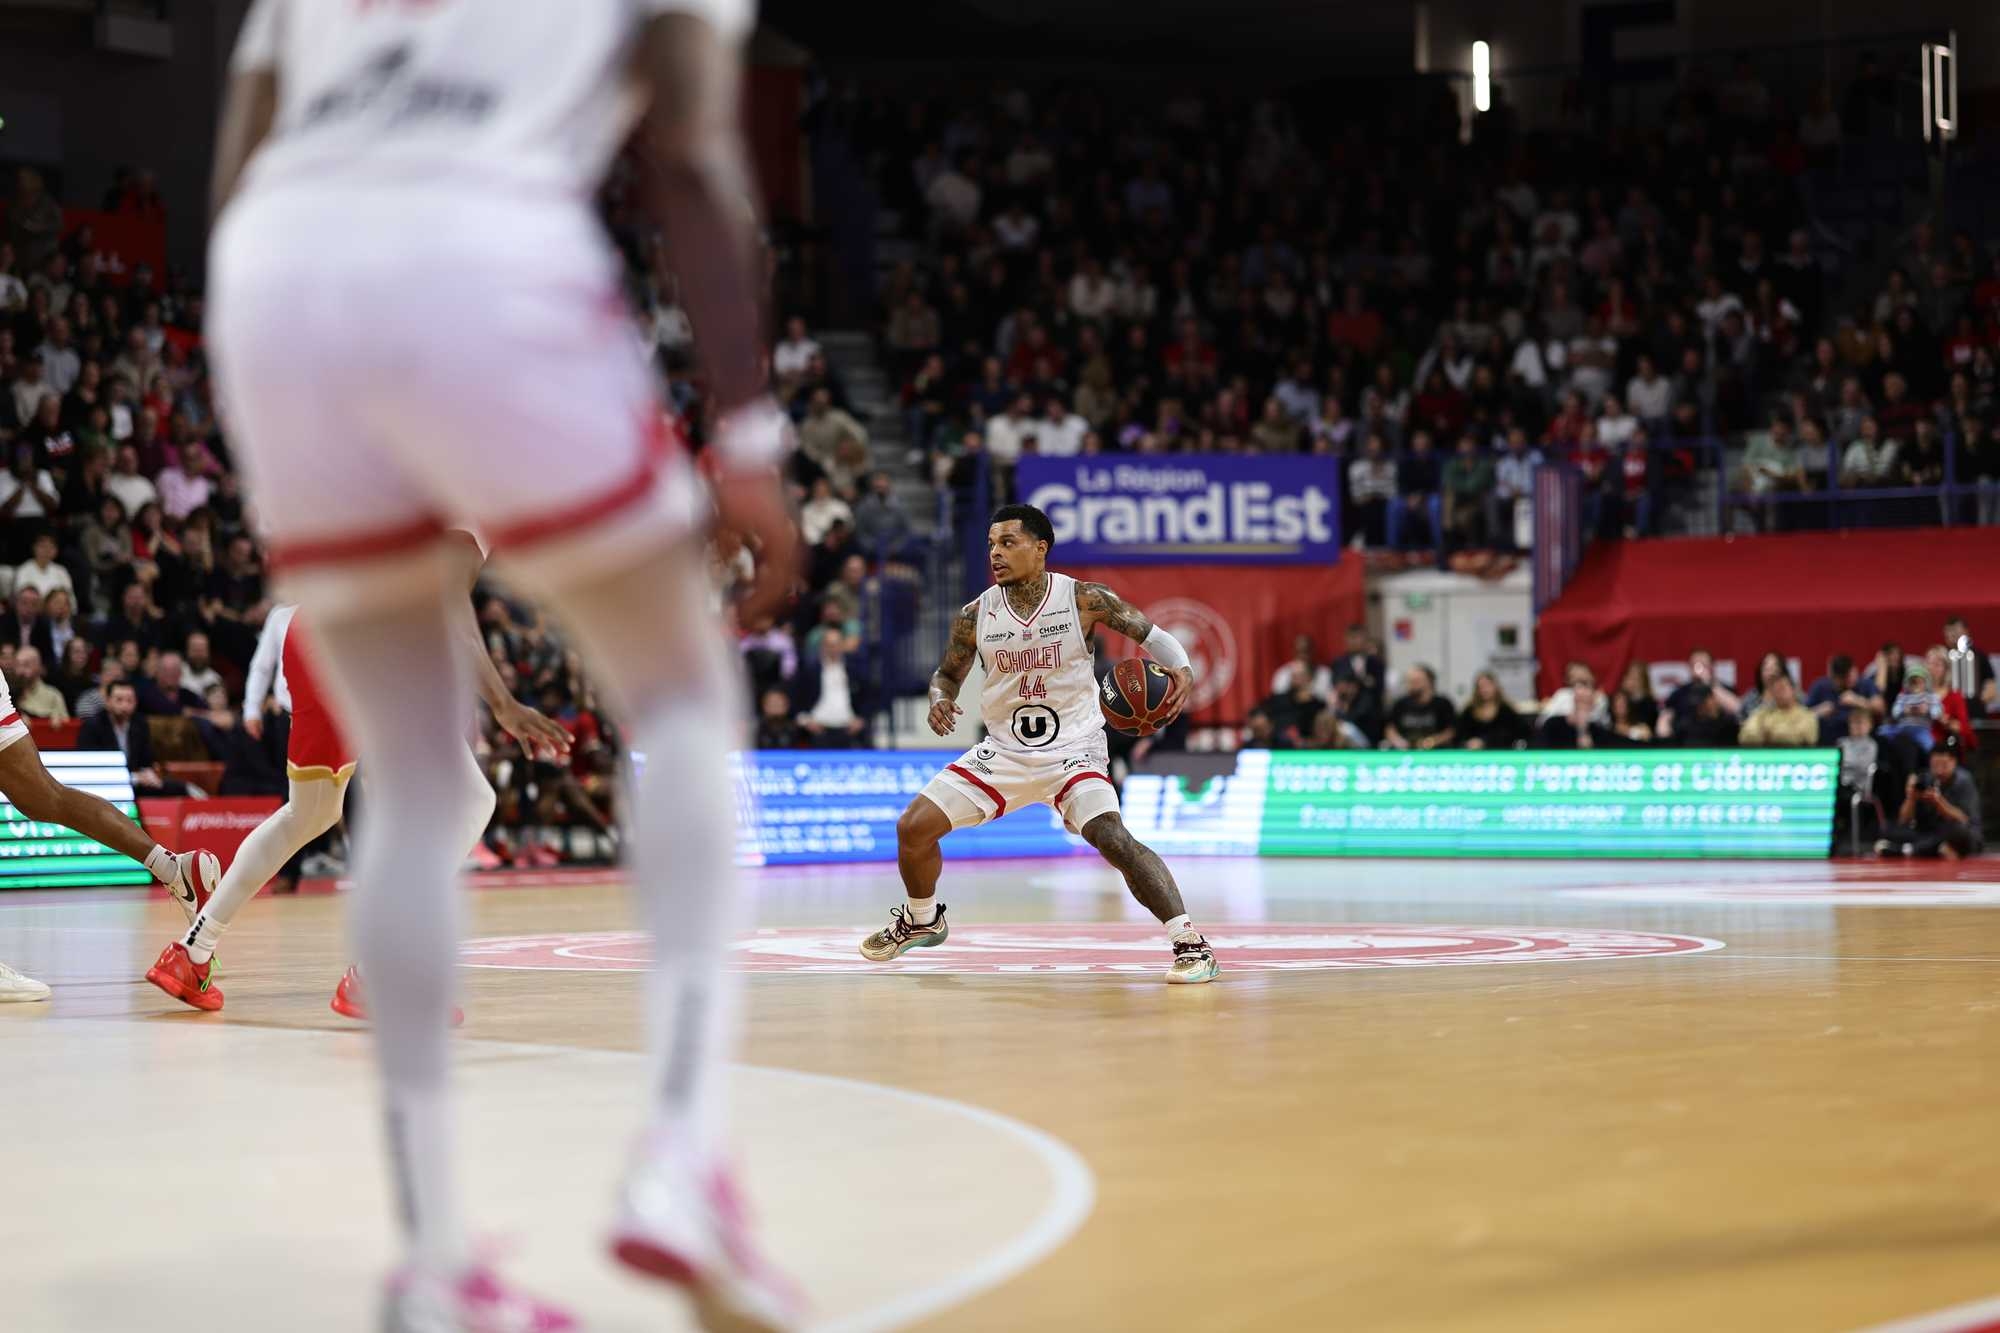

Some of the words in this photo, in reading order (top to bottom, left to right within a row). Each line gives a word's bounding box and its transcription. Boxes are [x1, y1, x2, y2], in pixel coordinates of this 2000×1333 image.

[1076, 466, 1112, 491] La
[1114, 464, 1206, 494] Région
[996, 641, 1063, 673] CHOLET
[1019, 675, 1047, 700] 44
[1020, 716, 1047, 738] U
